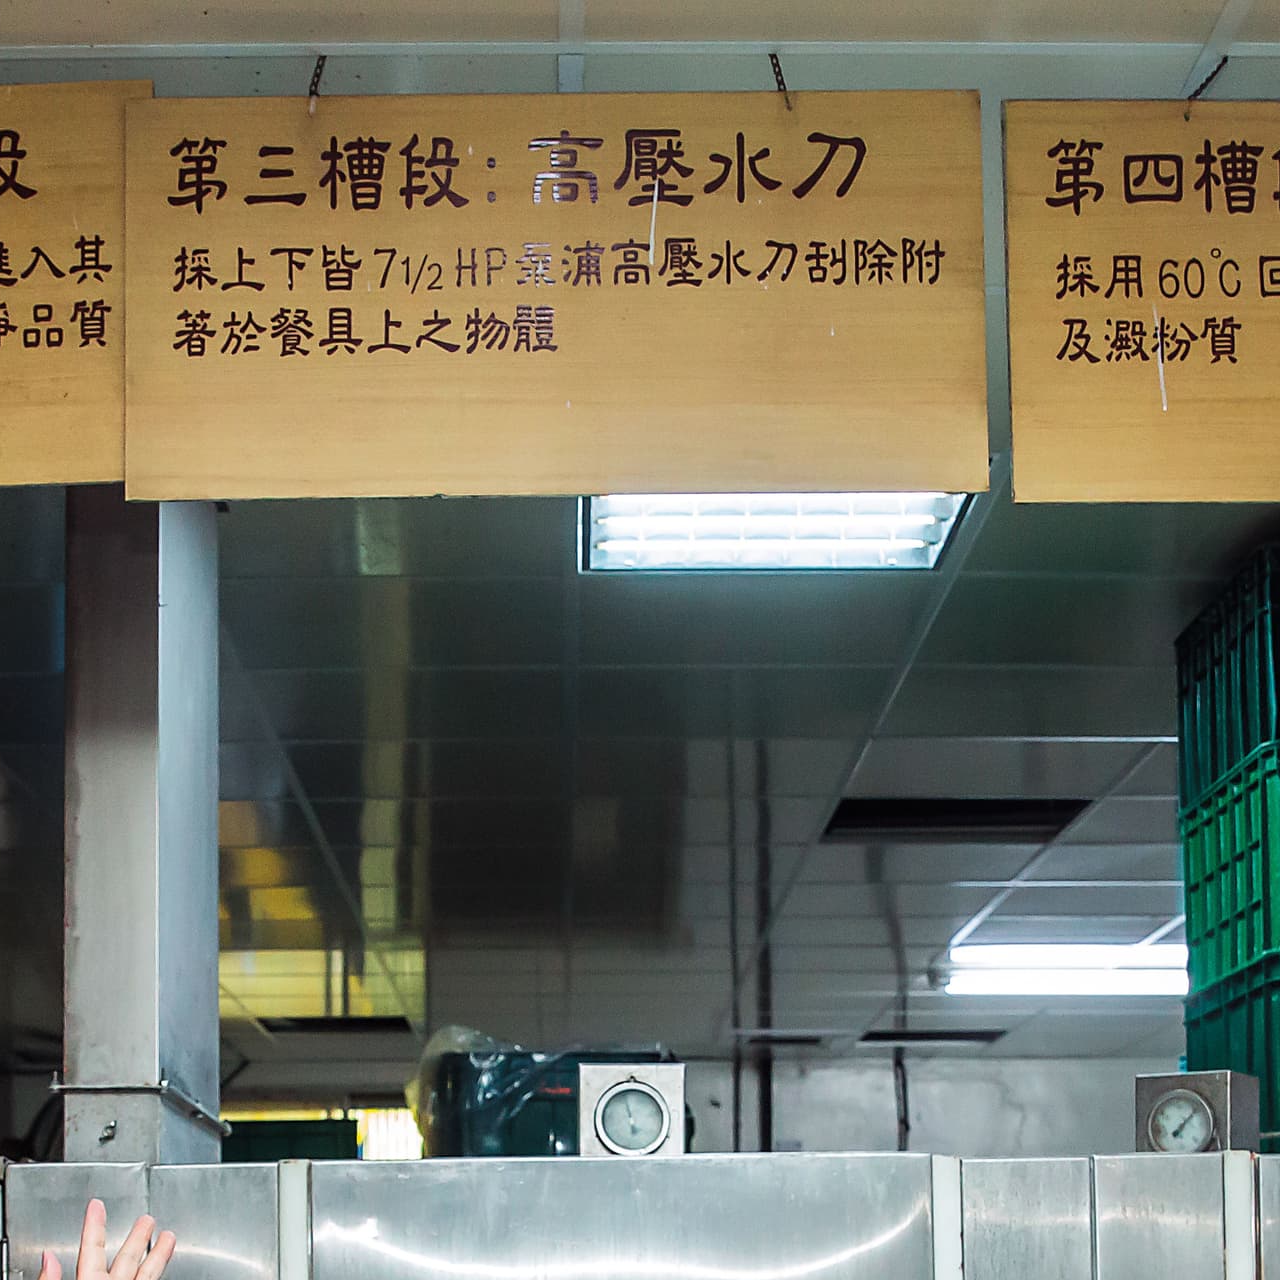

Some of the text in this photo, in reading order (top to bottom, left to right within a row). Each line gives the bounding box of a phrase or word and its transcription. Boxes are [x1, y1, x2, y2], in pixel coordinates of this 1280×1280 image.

[172, 305, 558, 357] 著於餐具上之物體
[1056, 316, 1242, 364] 及澱粉質
